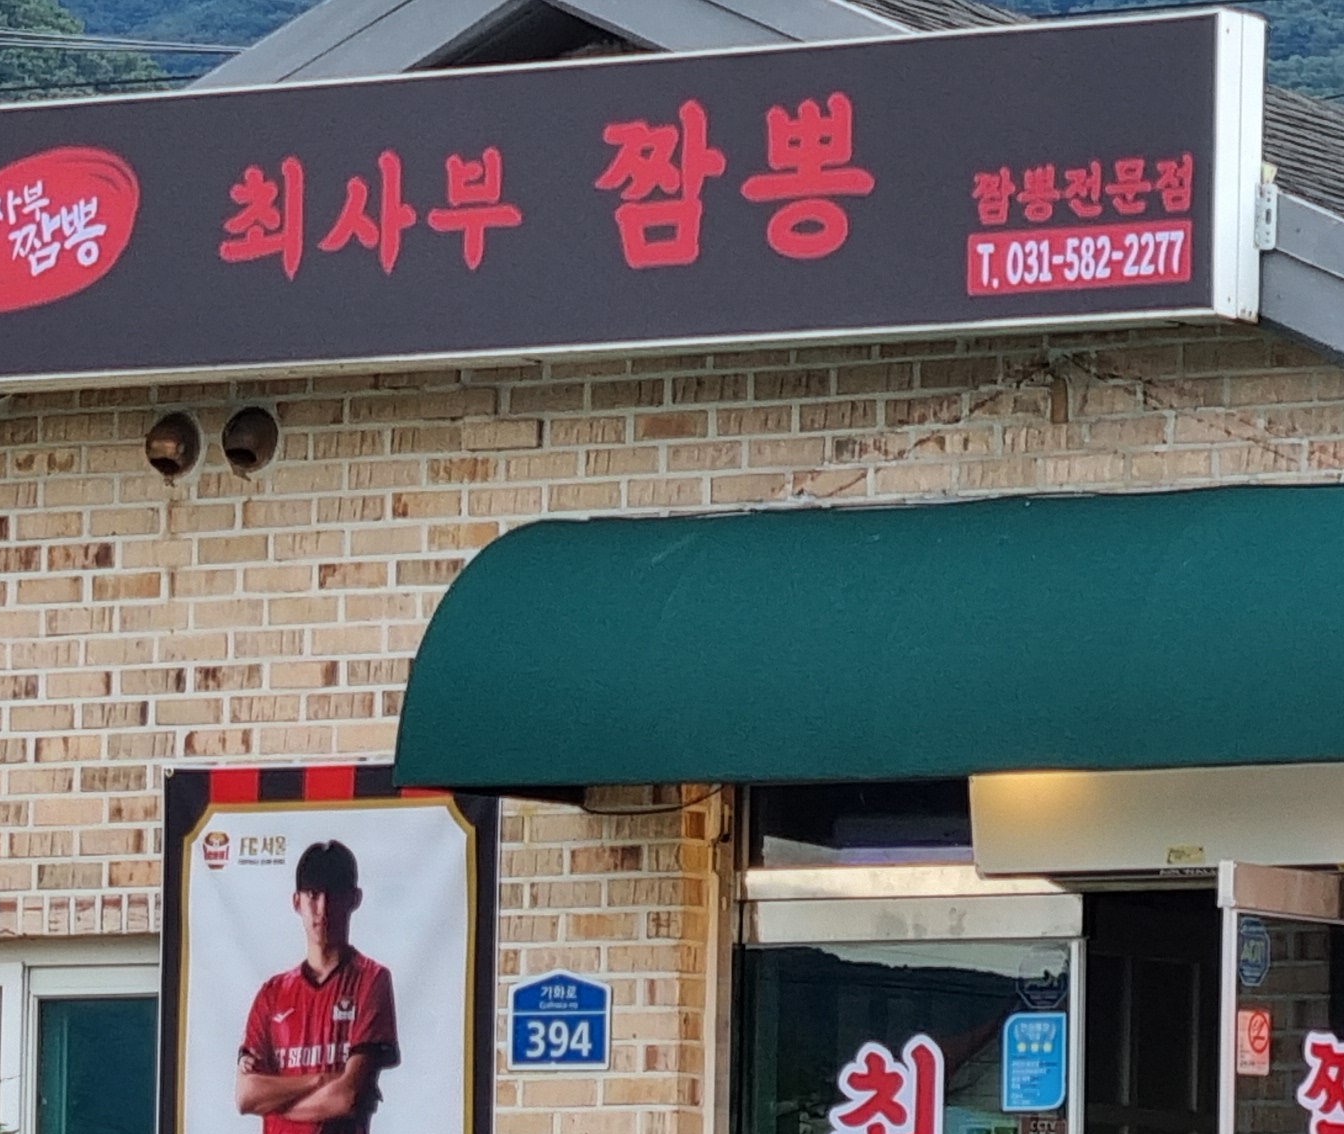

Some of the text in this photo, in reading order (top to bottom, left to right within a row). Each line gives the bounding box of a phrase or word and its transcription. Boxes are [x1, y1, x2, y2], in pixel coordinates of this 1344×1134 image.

[220, 92, 875, 281] 최사부 짬뽕
[971, 153, 1194, 225] 짬뽕전문점
[8, 196, 106, 277] 짬뽕
[1006, 230, 1184, 284] 031-582-2277
[526, 1020, 592, 1058] 394
